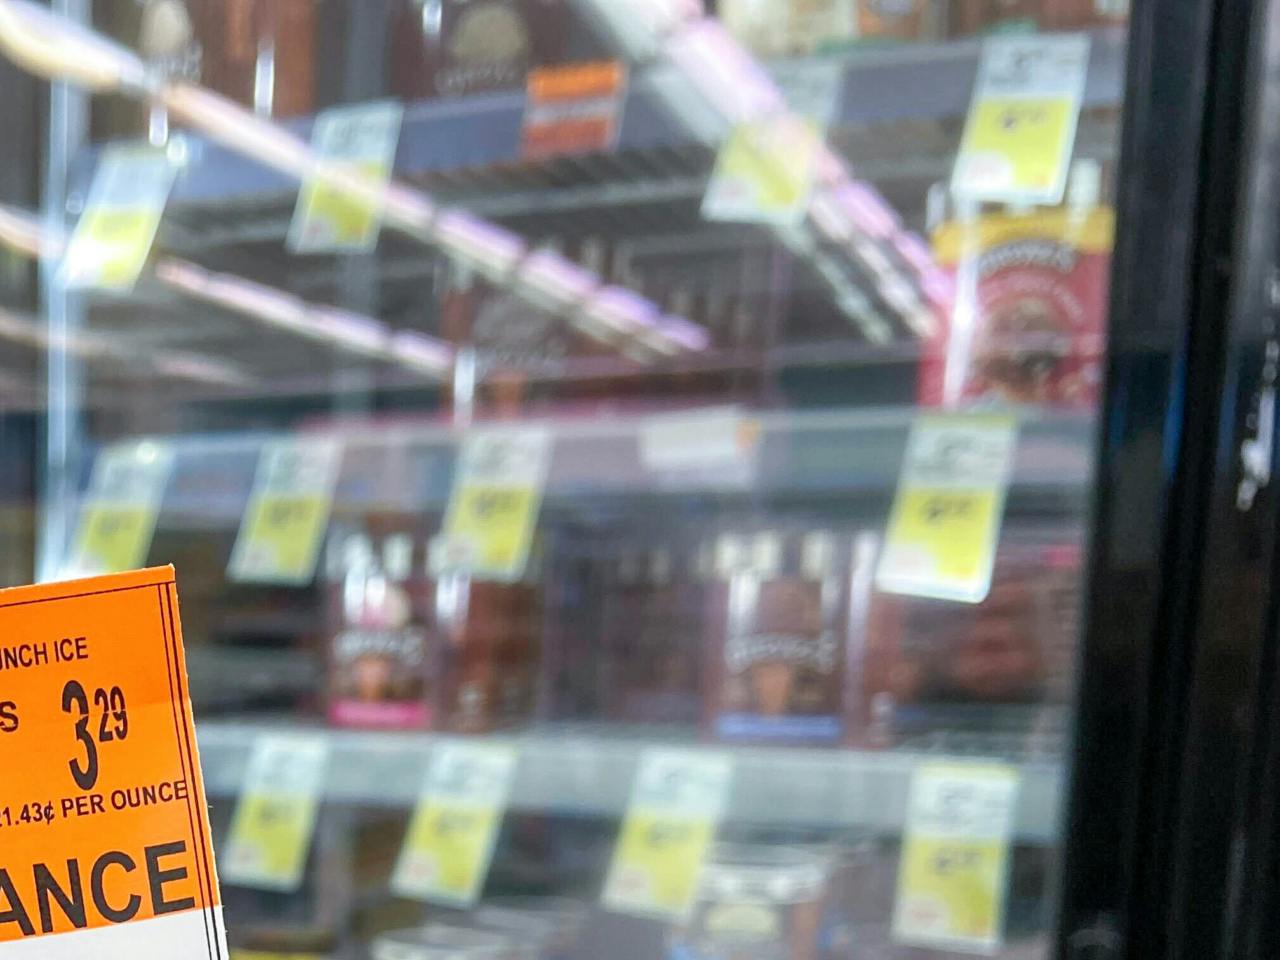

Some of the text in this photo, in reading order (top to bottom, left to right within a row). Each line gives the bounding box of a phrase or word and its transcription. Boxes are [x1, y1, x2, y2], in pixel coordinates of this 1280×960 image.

[54, 636, 89, 662] ICE
[61, 793, 105, 818] PER
[111, 780, 188, 810] OUNCE
